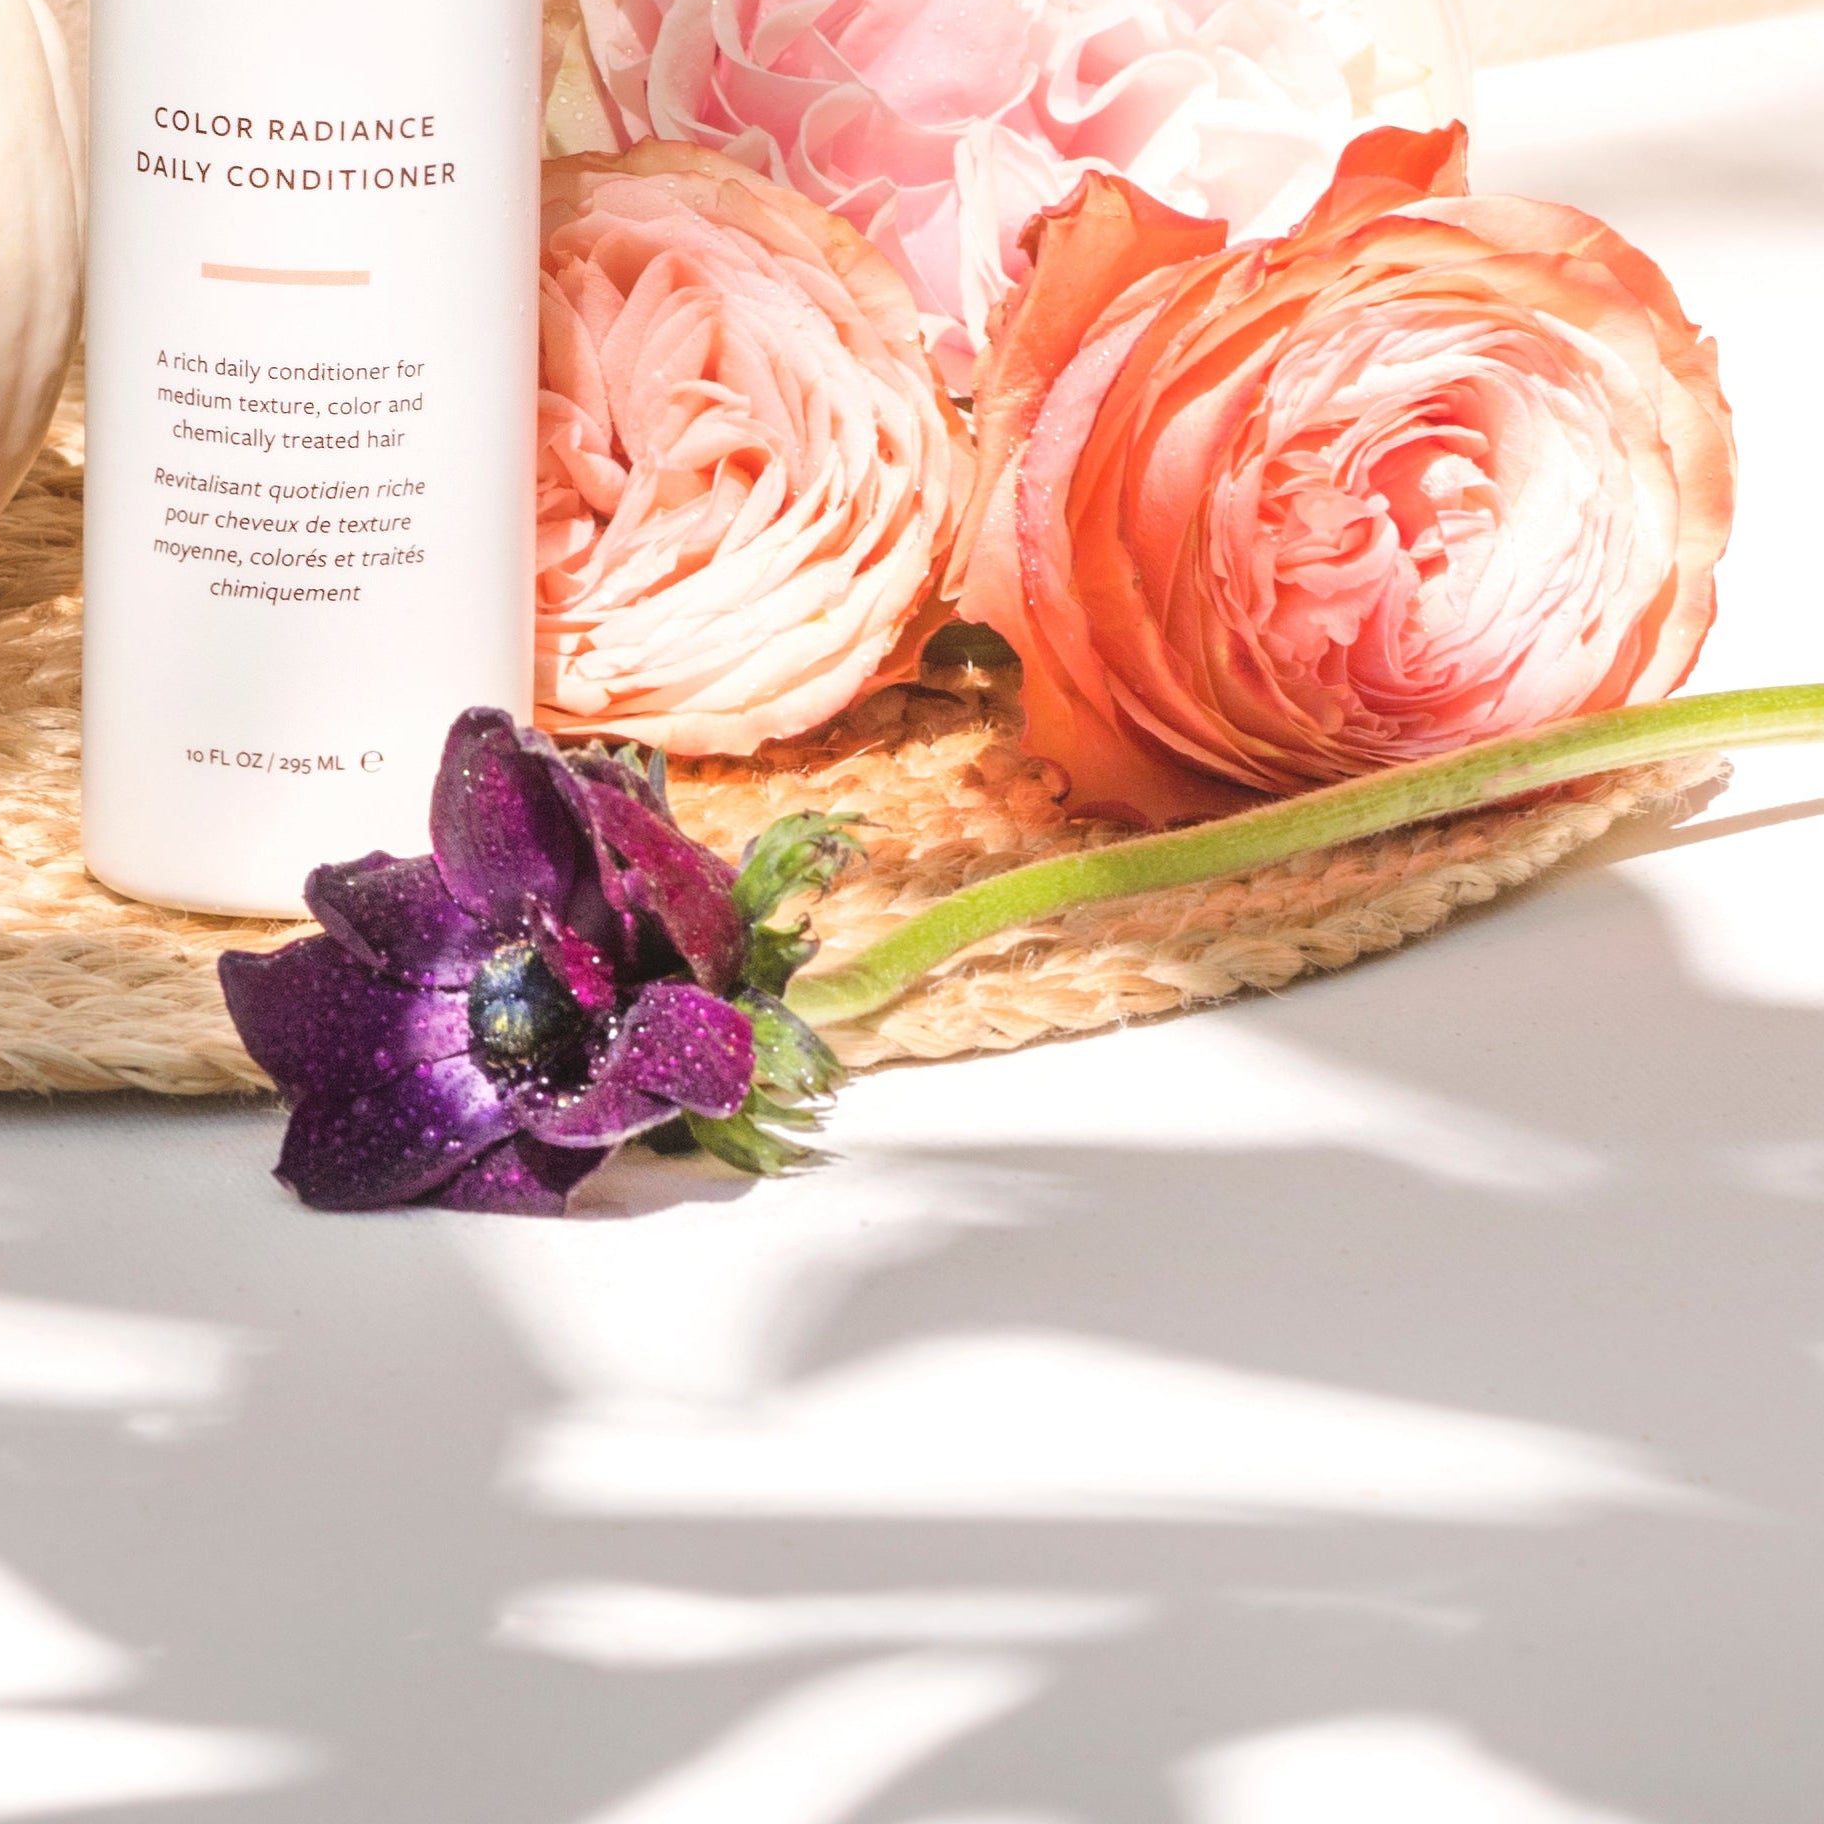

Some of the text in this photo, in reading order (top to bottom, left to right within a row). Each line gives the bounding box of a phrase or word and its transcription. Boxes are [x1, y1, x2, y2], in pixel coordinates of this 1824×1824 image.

[155, 107, 434, 141] COLOR RADIANCE
[137, 151, 454, 190] DAILY CONDITIONER
[157, 350, 425, 384] A rich daily conditioner for
[158, 388, 423, 418] medium texture, color and
[173, 419, 405, 453] chemically treated hair
[155, 467, 425, 504] Revitalisant quotidien riche
[165, 507, 411, 533] pour cheveux de texture
[154, 539, 424, 568] moyenne, colorés et traités
[210, 578, 361, 606] chimiquement
[186, 749, 204, 763] 10
[209, 749, 230, 766] FL
[236, 751, 263, 769] OZ
[279, 758, 311, 775] 295
[318, 755, 345, 771] ML
